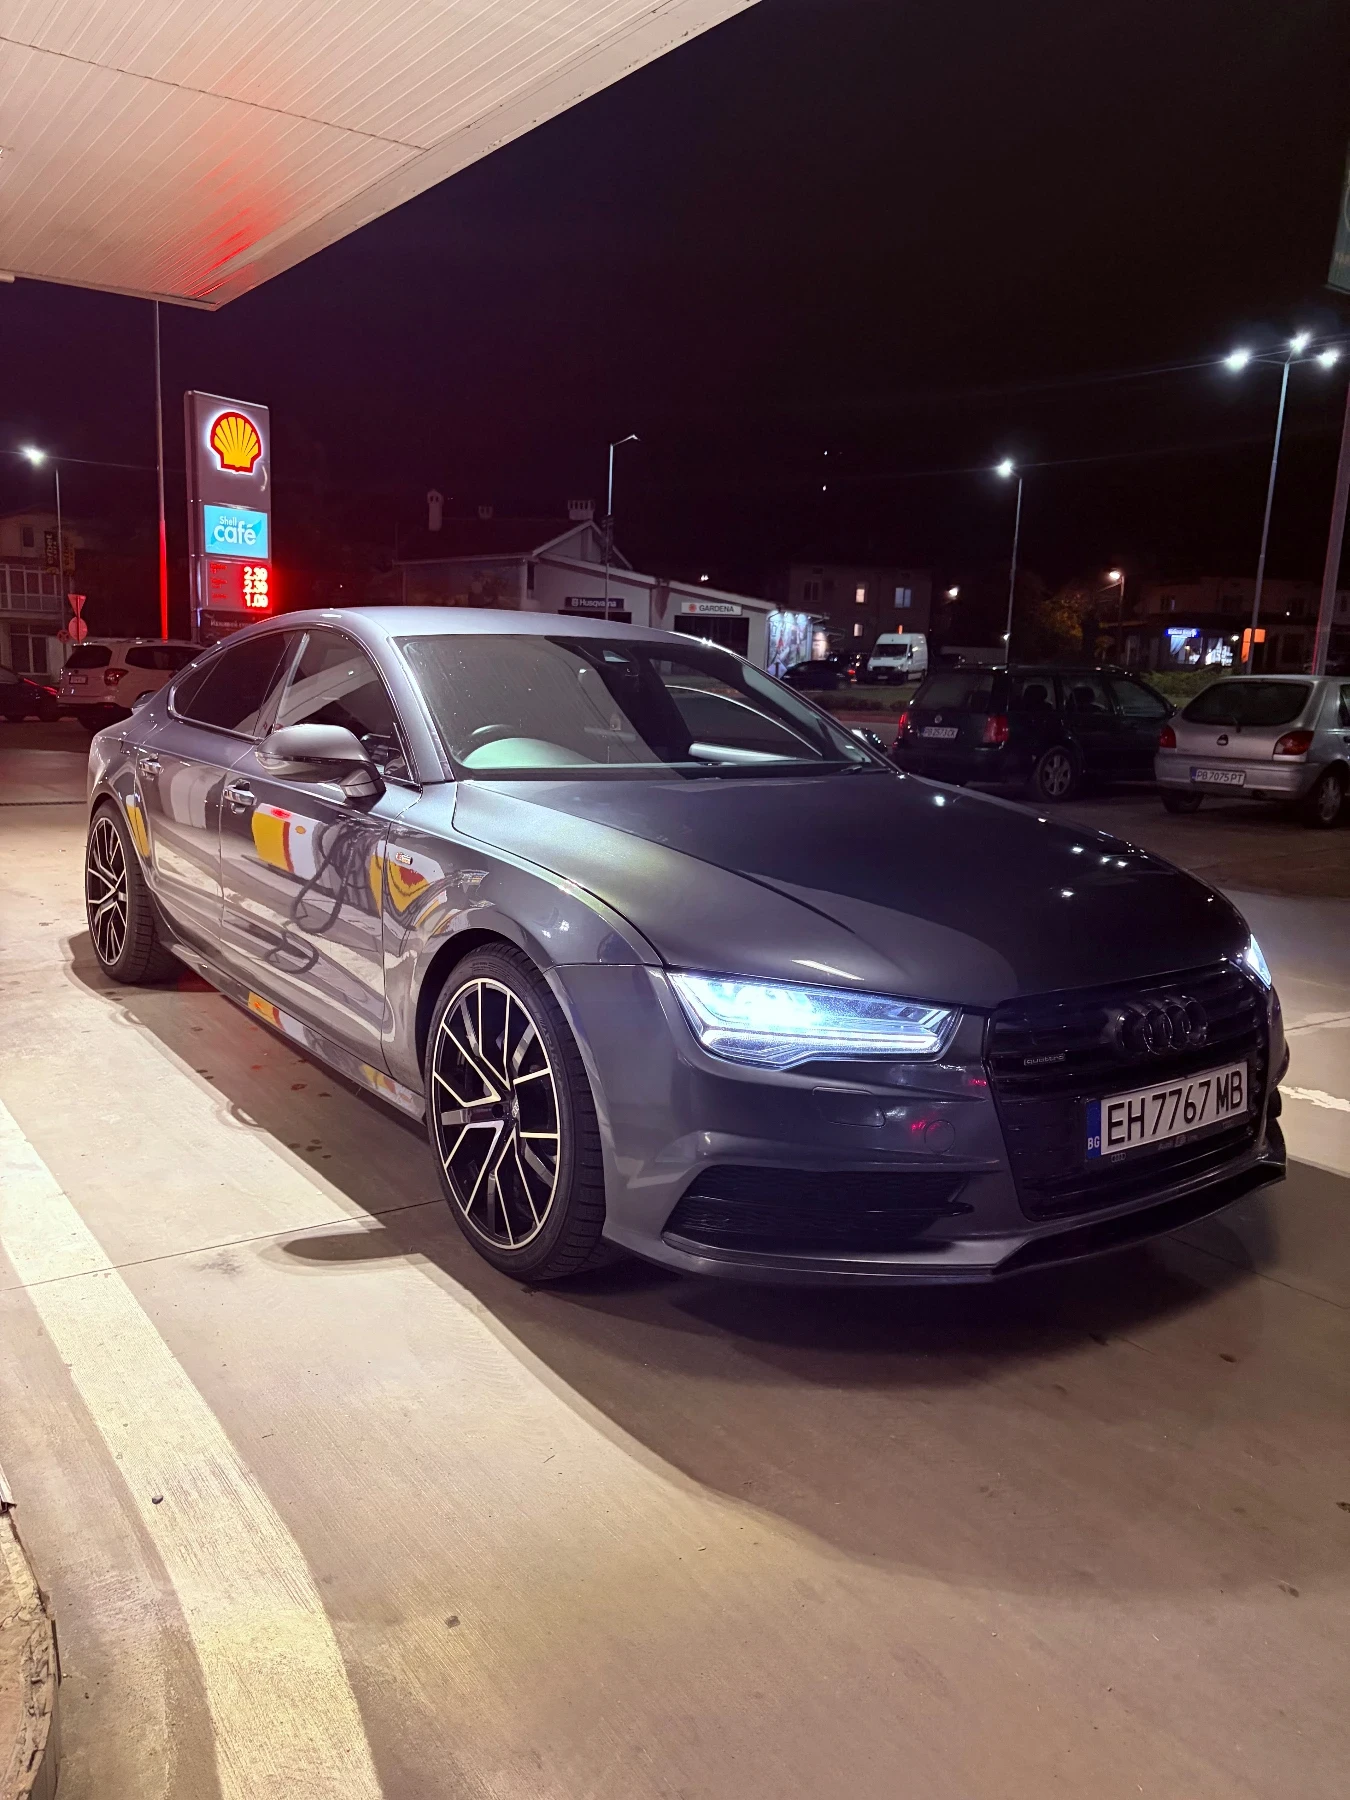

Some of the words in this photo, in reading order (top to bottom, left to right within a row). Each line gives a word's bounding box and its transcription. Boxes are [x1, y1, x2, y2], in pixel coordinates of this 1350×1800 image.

[220, 516, 237, 526] Shell
[213, 520, 257, 545] café
[579, 599, 617, 608] Husqvana
[699, 605, 734, 613] GARDENA
[1087, 1136, 1100, 1150] BG
